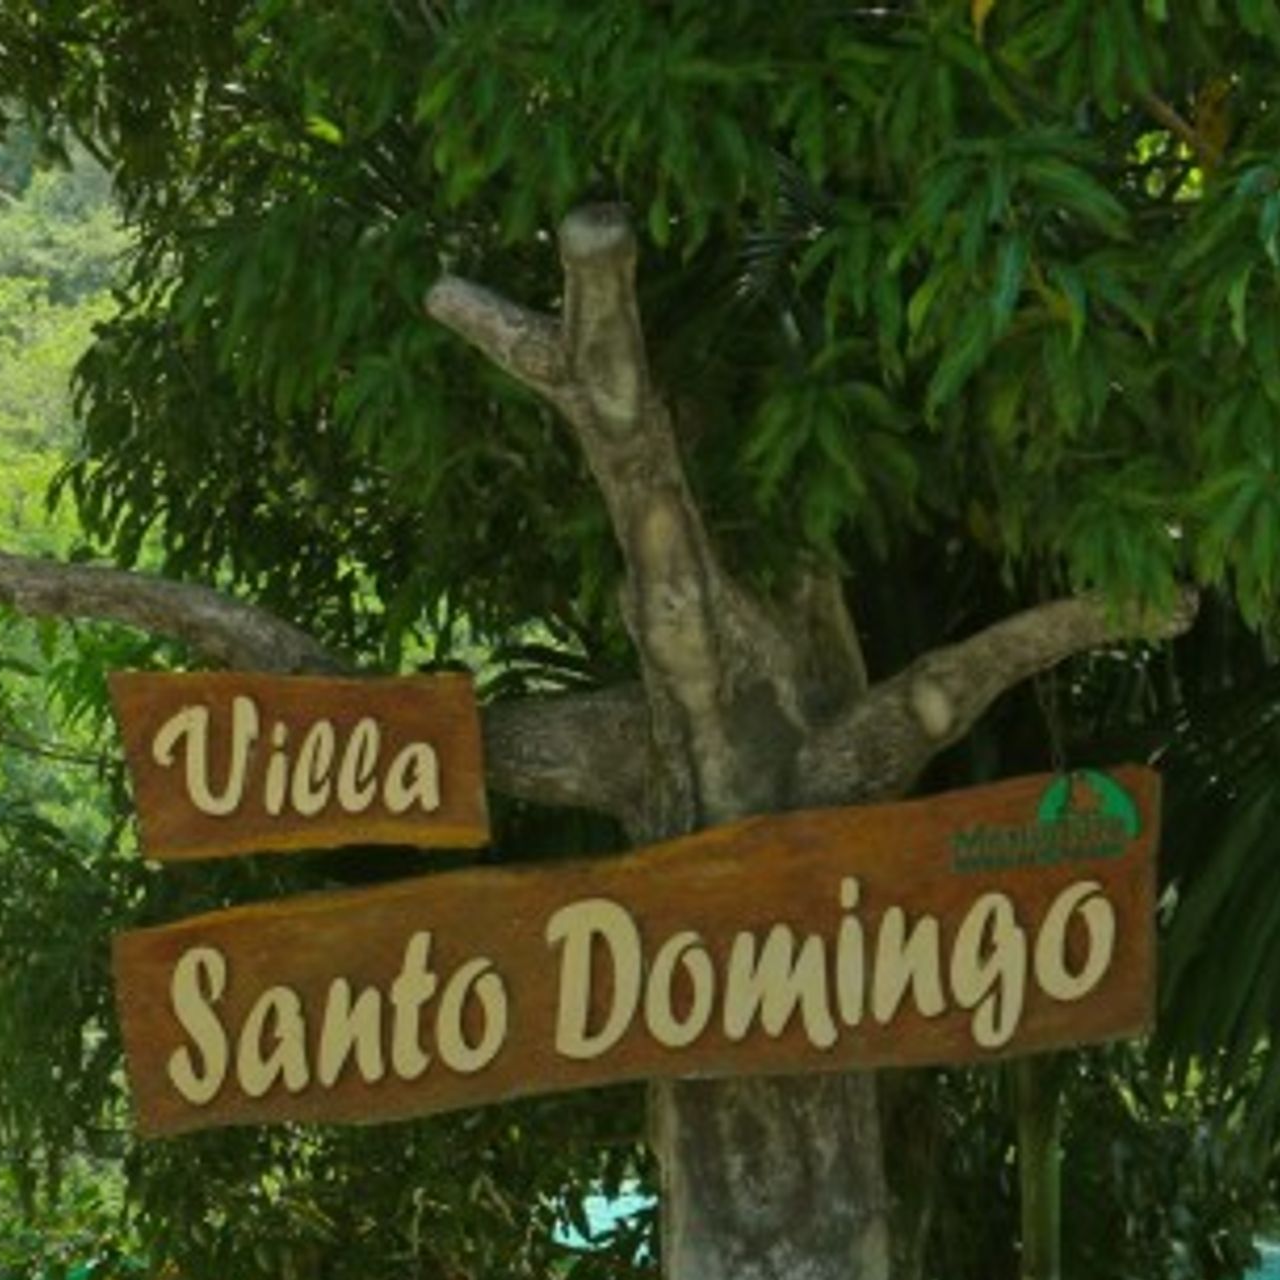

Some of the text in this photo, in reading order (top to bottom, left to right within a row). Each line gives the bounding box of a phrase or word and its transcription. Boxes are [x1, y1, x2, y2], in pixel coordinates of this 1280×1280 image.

[152, 695, 441, 816] Villa
[167, 877, 1117, 1105] Santo Domingo
